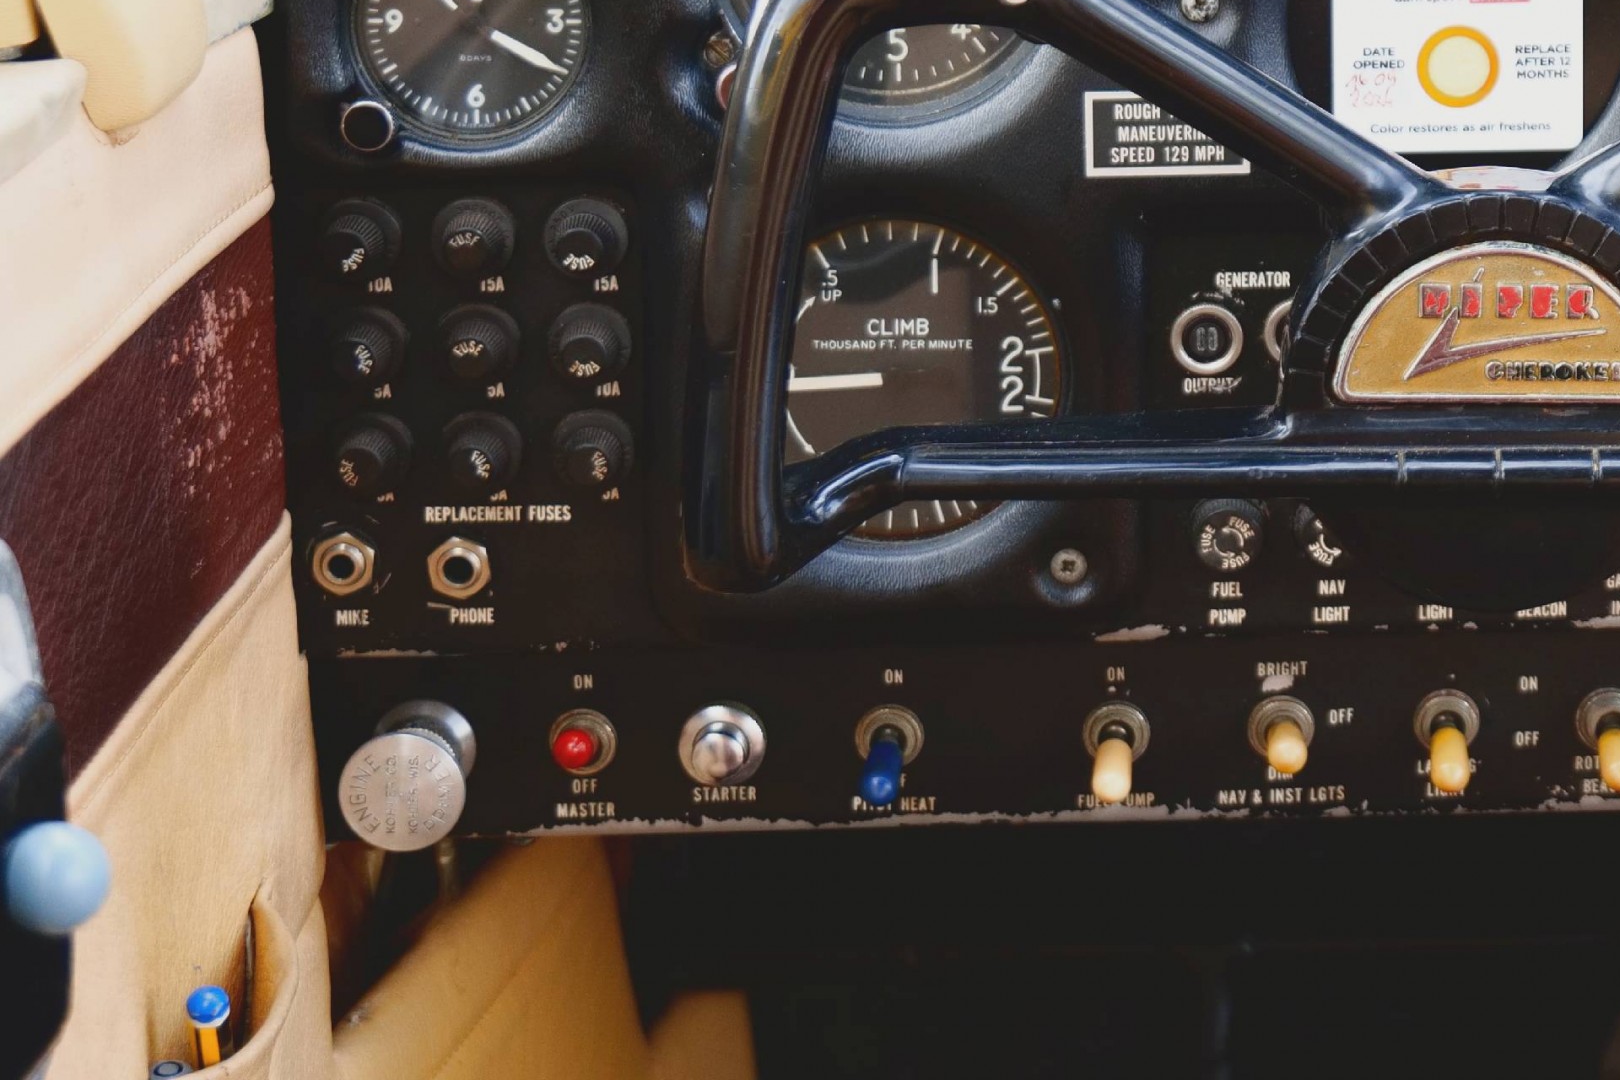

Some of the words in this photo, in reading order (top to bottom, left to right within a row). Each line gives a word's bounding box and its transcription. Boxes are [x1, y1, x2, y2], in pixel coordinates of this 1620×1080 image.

[1363, 48, 1395, 56] DATE
[1516, 44, 1571, 54] REPLACE
[1354, 60, 1404, 69] OPENED
[1516, 58, 1555, 66] AFTER
[1560, 57, 1571, 66] 12
[1517, 70, 1569, 78] MONTHS
[1115, 104, 1160, 119] ROUGH
[1370, 124, 1403, 133] Color
[1408, 123, 1458, 132] restores
[1463, 124, 1476, 132] as
[1480, 122, 1494, 132] air
[1499, 122, 1551, 131] freshens
[1112, 147, 1155, 162] SPEED
[1164, 146, 1189, 161] 129
[1195, 146, 1224, 161] MPH
[1216, 271, 1290, 289] GENERATOR
[978, 297, 998, 314] 1.5
[868, 319, 929, 336] CLIMB
[813, 340, 876, 350] THOUSAND
[880, 340, 898, 350] FT.
[902, 340, 924, 350] PER
[928, 339, 973, 350] MINUTE
[425, 506, 521, 522] REPLACEMENT
[529, 505, 571, 520] FUSES
[1213, 582, 1242, 597] FUEL
[1319, 579, 1346, 596] NAV
[336, 610, 369, 625] MIKE
[450, 608, 494, 623] PHONE
[1210, 609, 1246, 624] PUMP
[1314, 606, 1350, 622] LIGHT
[1107, 667, 1125, 681] ON
[1257, 661, 1308, 678] BRIGHT
[574, 675, 593, 689] ON
[1520, 676, 1538, 691] ON
[1330, 708, 1354, 724] OFF
[1516, 731, 1540, 747] OFF
[572, 779, 597, 793] OFF
[693, 787, 756, 801] STARTER
[1219, 788, 1248, 804] NAV
[1253, 788, 1263, 803] &
[1269, 788, 1300, 803] INST
[1310, 786, 1345, 803] LGTS
[557, 802, 614, 817] MASTER
[902, 797, 935, 811] HEAT
